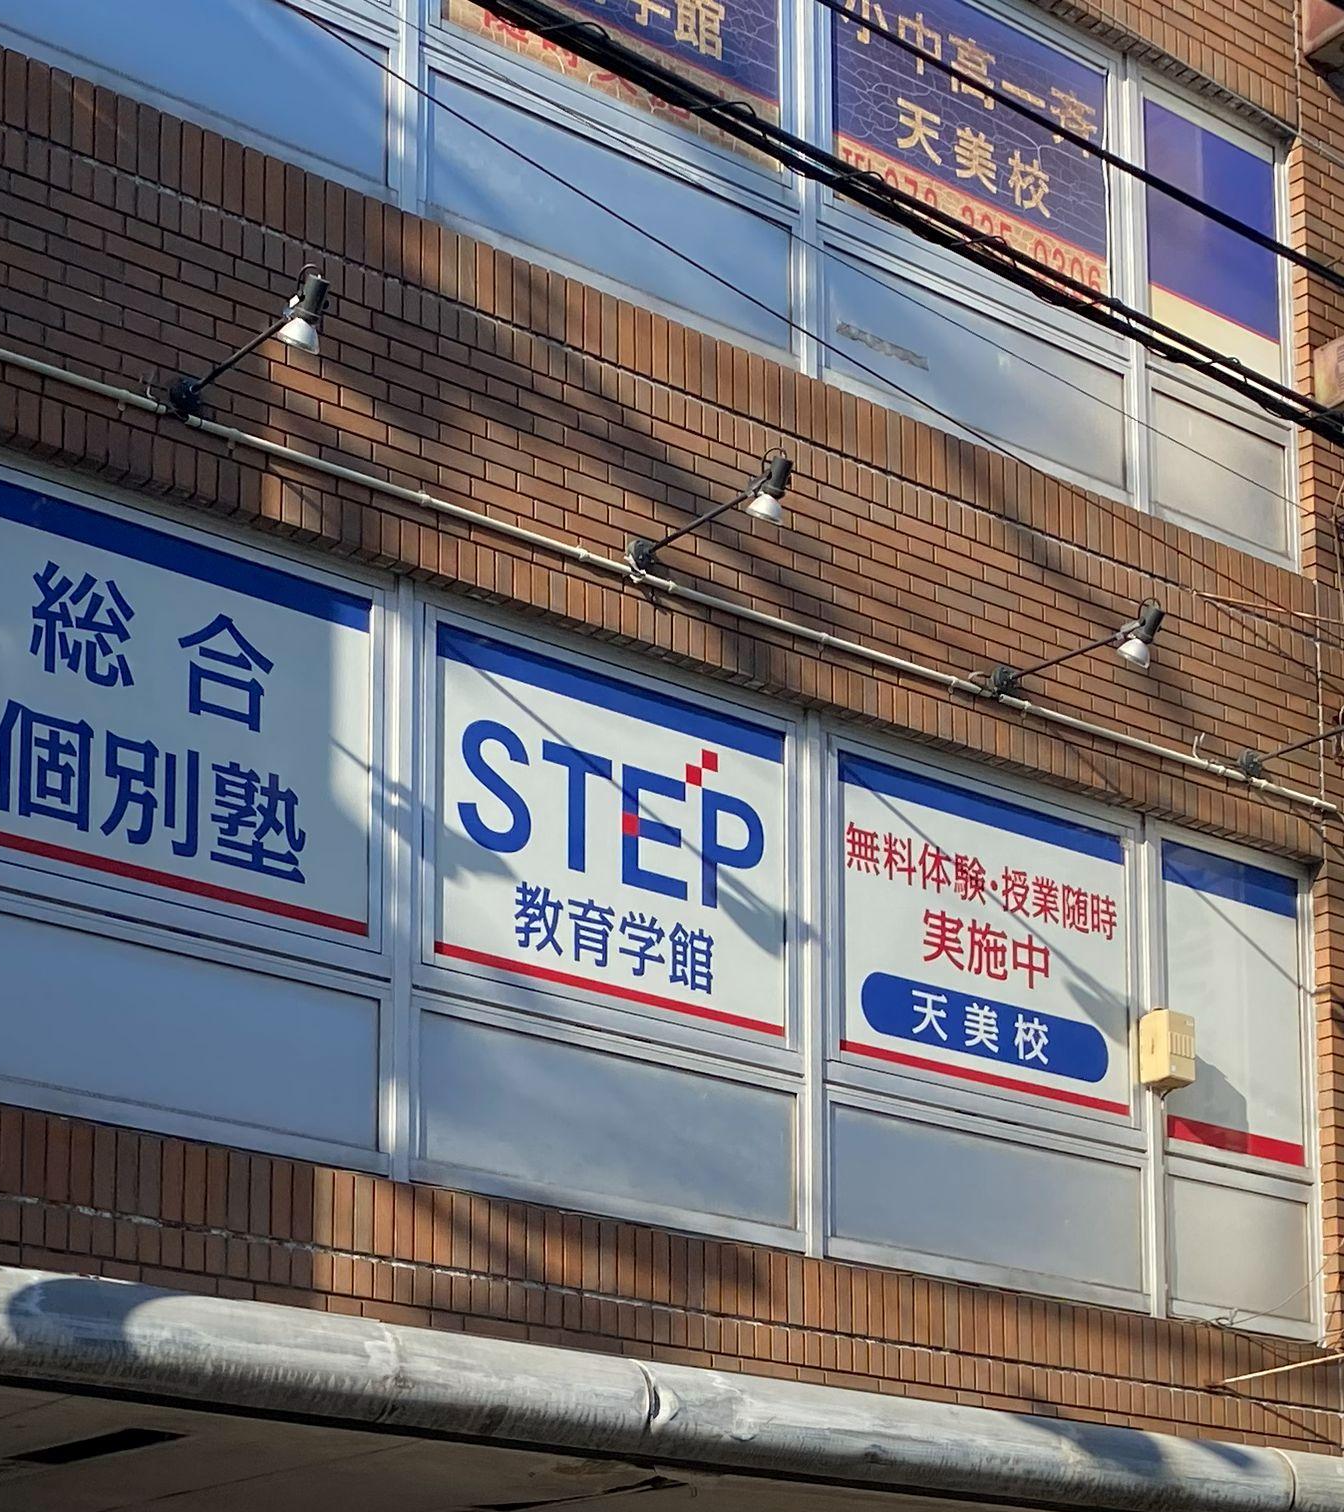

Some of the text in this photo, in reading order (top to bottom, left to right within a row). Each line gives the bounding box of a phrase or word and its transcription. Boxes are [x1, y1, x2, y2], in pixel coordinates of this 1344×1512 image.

[896, 97, 1051, 219] 天美校
[29, 559, 275, 732] 総合
[457, 718, 766, 909] STEP
[513, 881, 716, 996] 教育学館
[844, 821, 1118, 941] 無料体験・授業随時
[922, 908, 1051, 990] 実施中
[911, 988, 1050, 1066] 天美校
